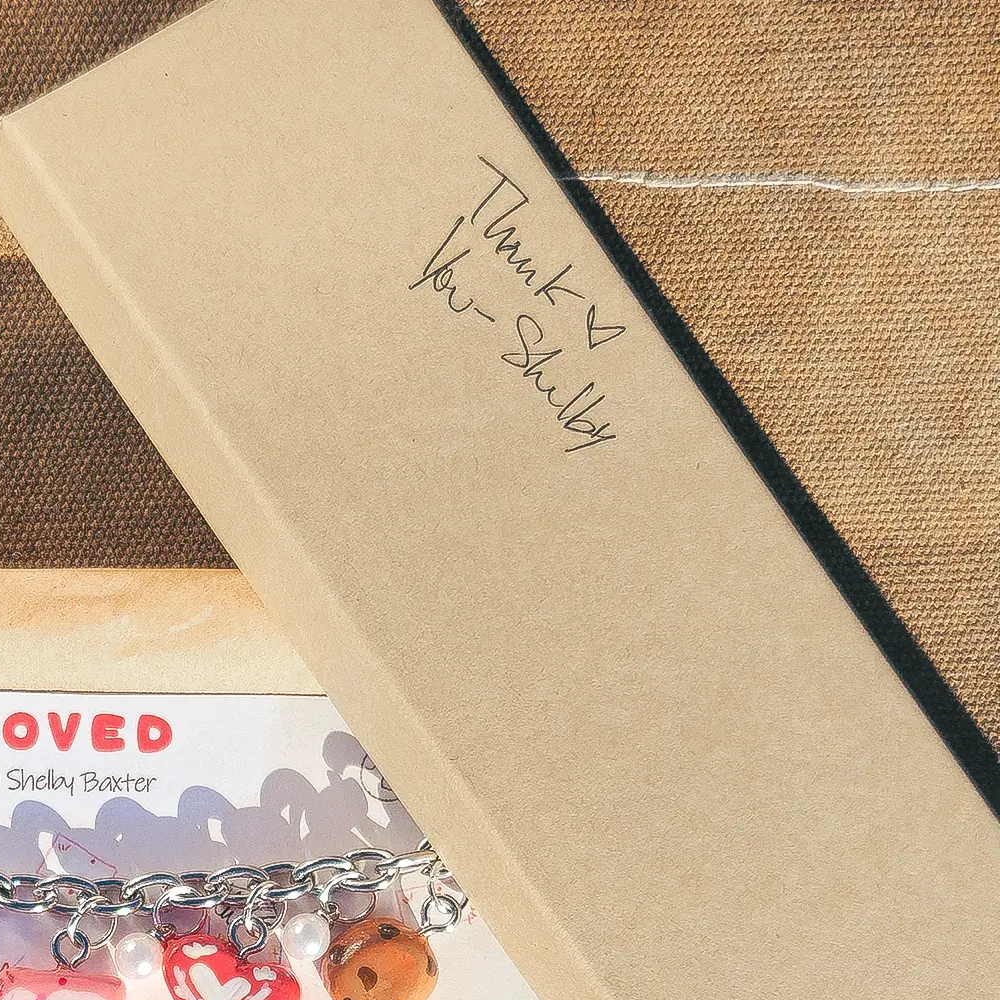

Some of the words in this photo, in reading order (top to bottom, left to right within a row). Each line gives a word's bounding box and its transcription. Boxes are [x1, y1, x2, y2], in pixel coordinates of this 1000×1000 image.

[471, 155, 586, 307] Thank
[500, 314, 617, 453] Shelby
[6, 770, 77, 797] Shelby
[80, 771, 158, 793] Baxter
